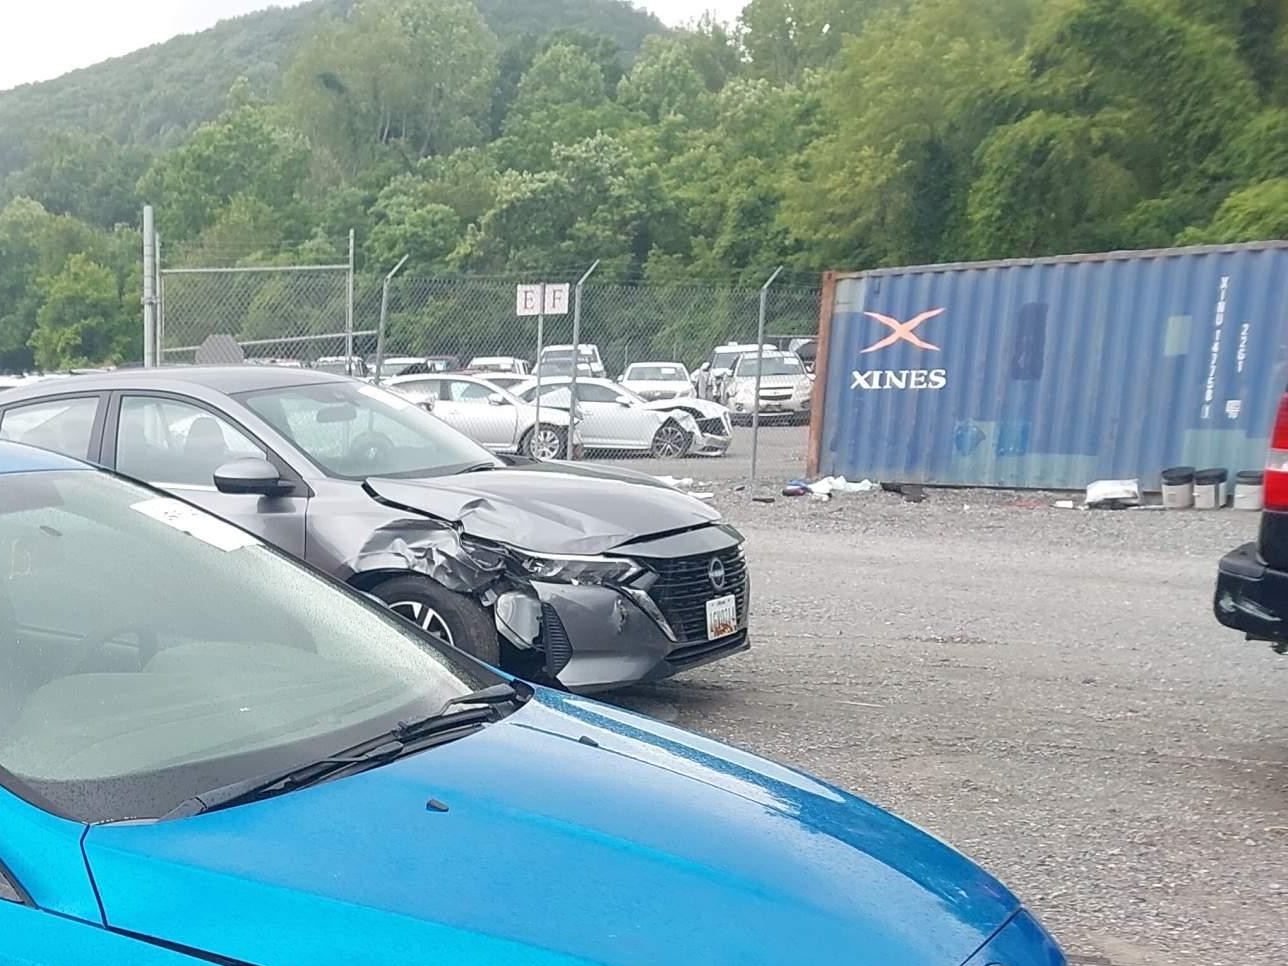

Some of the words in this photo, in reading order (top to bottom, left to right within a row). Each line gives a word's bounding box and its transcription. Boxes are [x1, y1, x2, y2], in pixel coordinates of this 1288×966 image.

[523, 290, 534, 309] E
[552, 289, 563, 308] F
[850, 369, 947, 389] XINES
